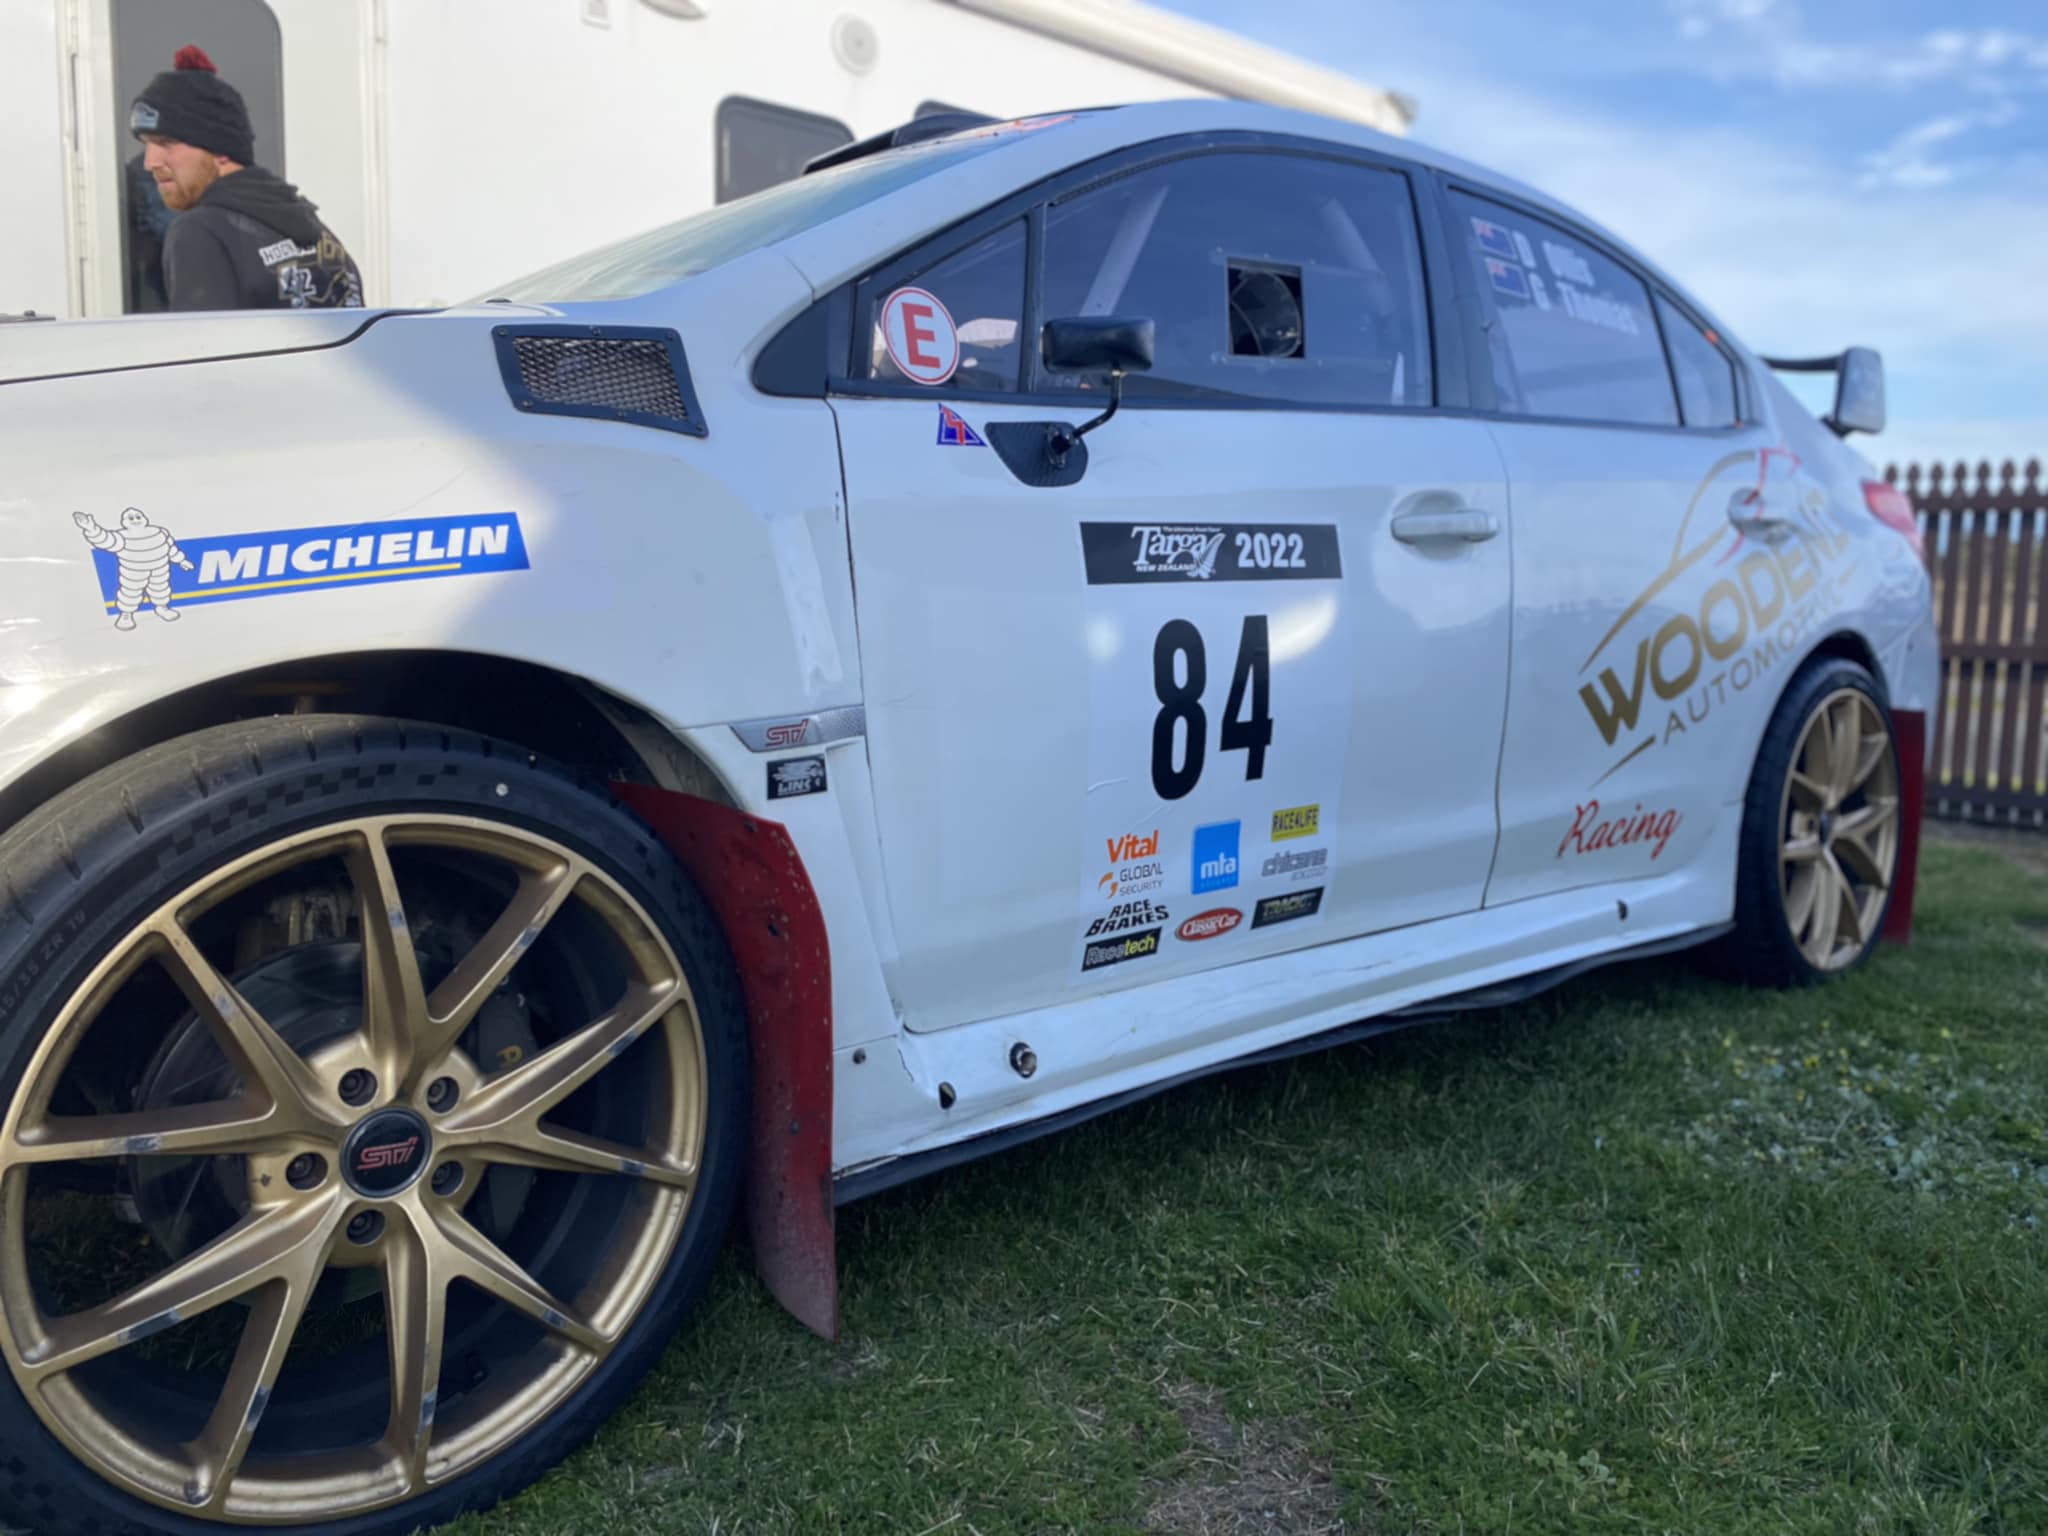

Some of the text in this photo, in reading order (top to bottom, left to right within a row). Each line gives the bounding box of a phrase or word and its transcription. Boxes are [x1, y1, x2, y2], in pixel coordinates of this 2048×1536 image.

[902, 302, 941, 368] E
[198, 525, 508, 583] MICHELIN
[1130, 525, 1306, 568] Targa 2022
[1151, 614, 1274, 801] 84
[1107, 829, 1159, 864] Vital
[1556, 799, 1683, 861] Racing
[1120, 862, 1163, 882] GLOBAL
[1200, 852, 1236, 879] mta
[1120, 880, 1163, 896] SECURITY
[1084, 905, 1169, 938] BRAKES
[1108, 899, 1152, 919] RACE
